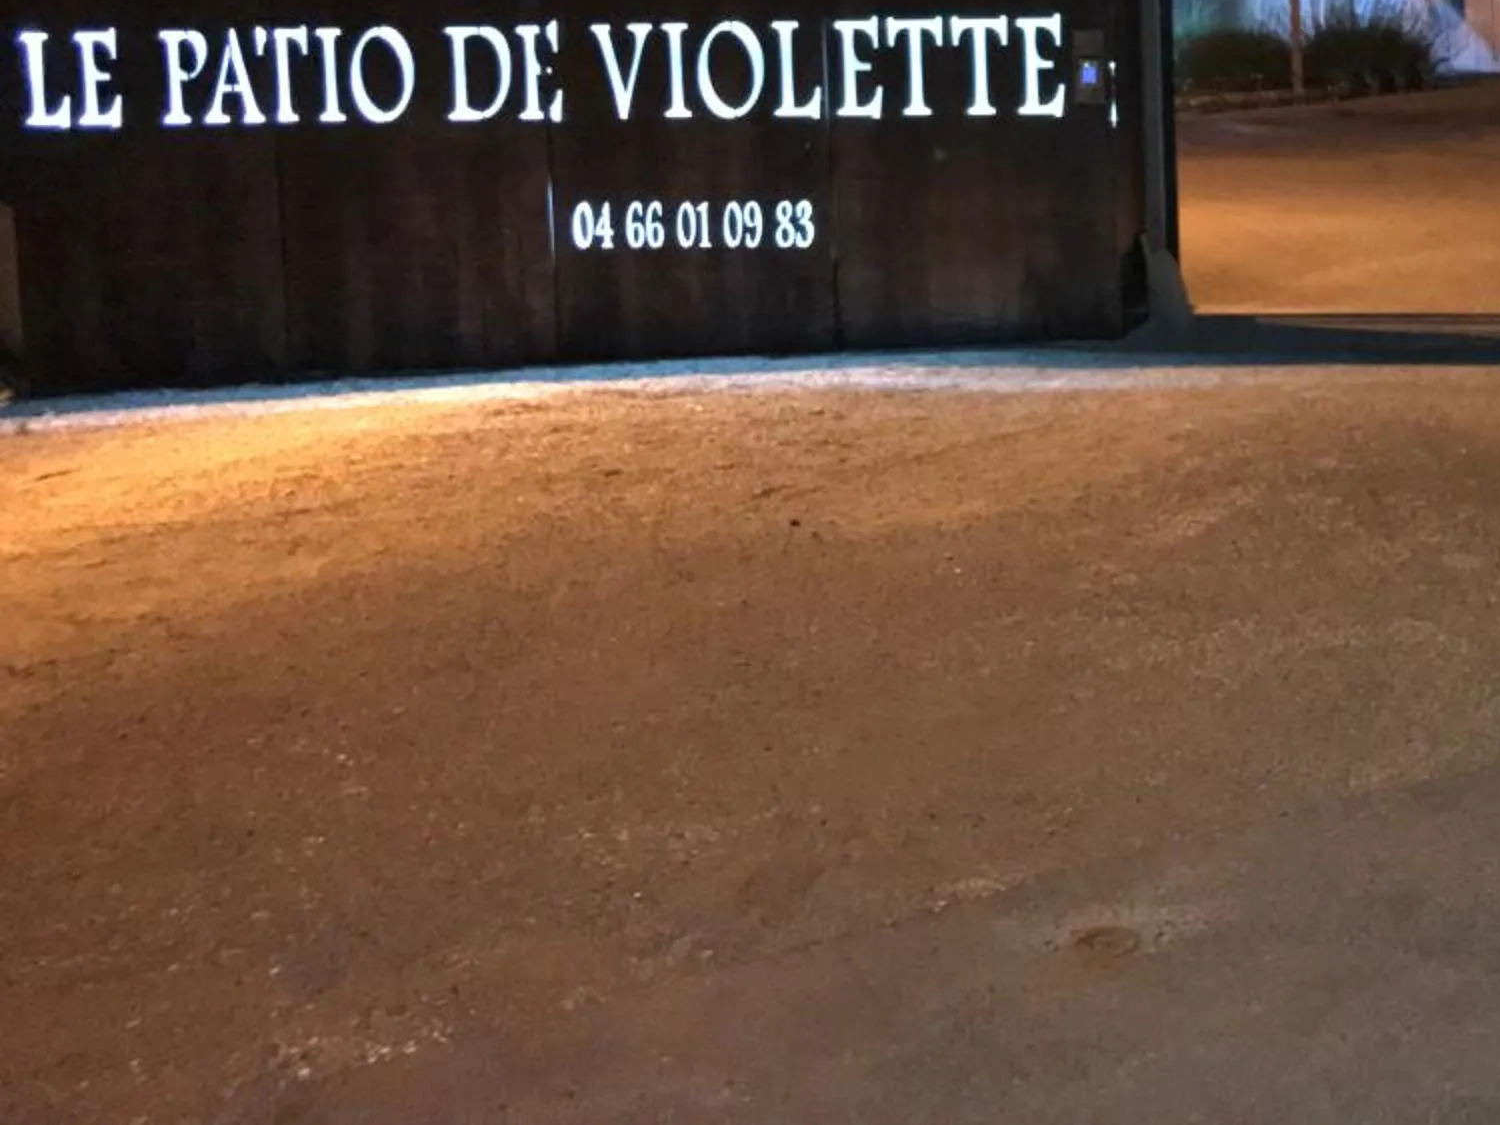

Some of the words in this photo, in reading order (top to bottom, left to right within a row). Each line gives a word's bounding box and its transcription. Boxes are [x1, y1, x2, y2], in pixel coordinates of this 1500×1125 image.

[18, 27, 123, 130] LE
[158, 24, 415, 127] PATIO
[443, 19, 564, 123] DE
[590, 12, 1066, 122] VIOLETTE
[571, 200, 615, 250] 04
[625, 200, 666, 249] 66
[675, 200, 713, 249] 01
[722, 200, 764, 249] 09
[774, 199, 815, 249] 83
